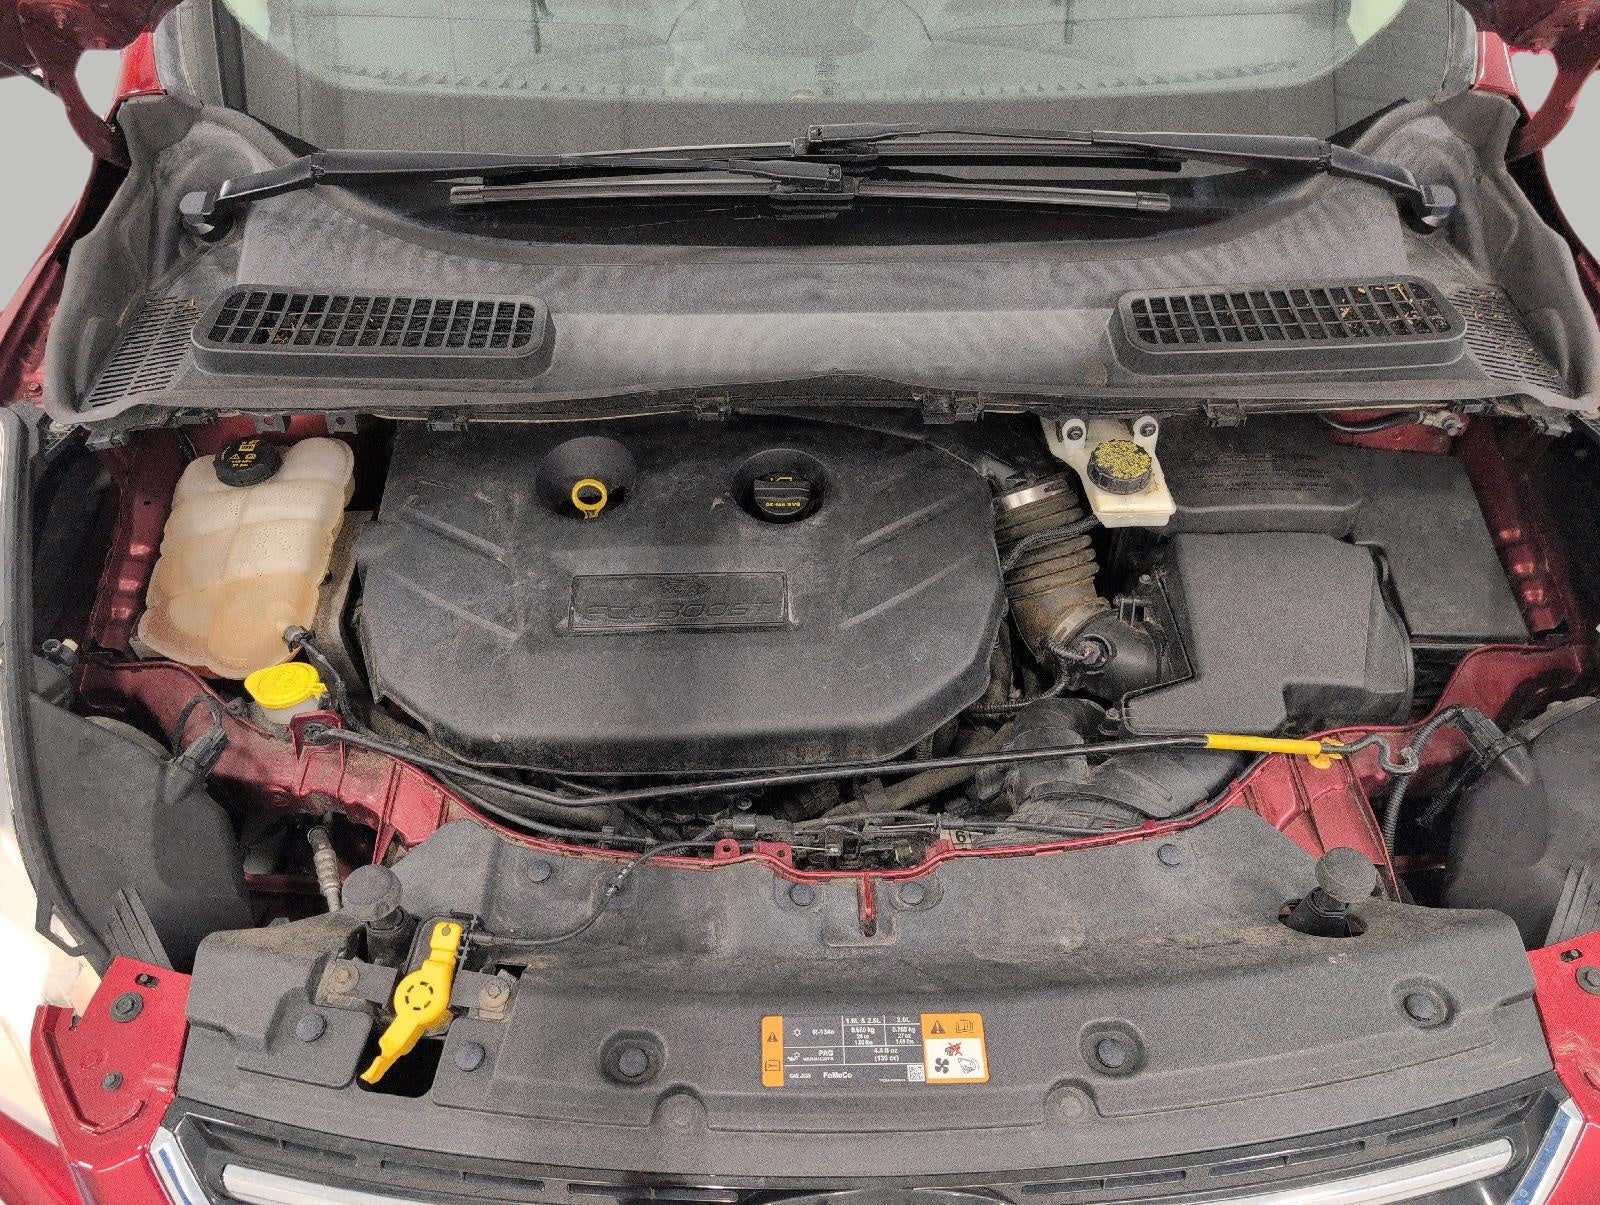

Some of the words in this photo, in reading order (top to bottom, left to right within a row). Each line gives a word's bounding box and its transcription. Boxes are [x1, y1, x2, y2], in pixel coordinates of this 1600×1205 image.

[955, 830, 967, 843] 6
[867, 1026, 876, 1034] kg
[818, 1049, 834, 1057] PAG
[822, 1071, 853, 1079] FoMoCo
